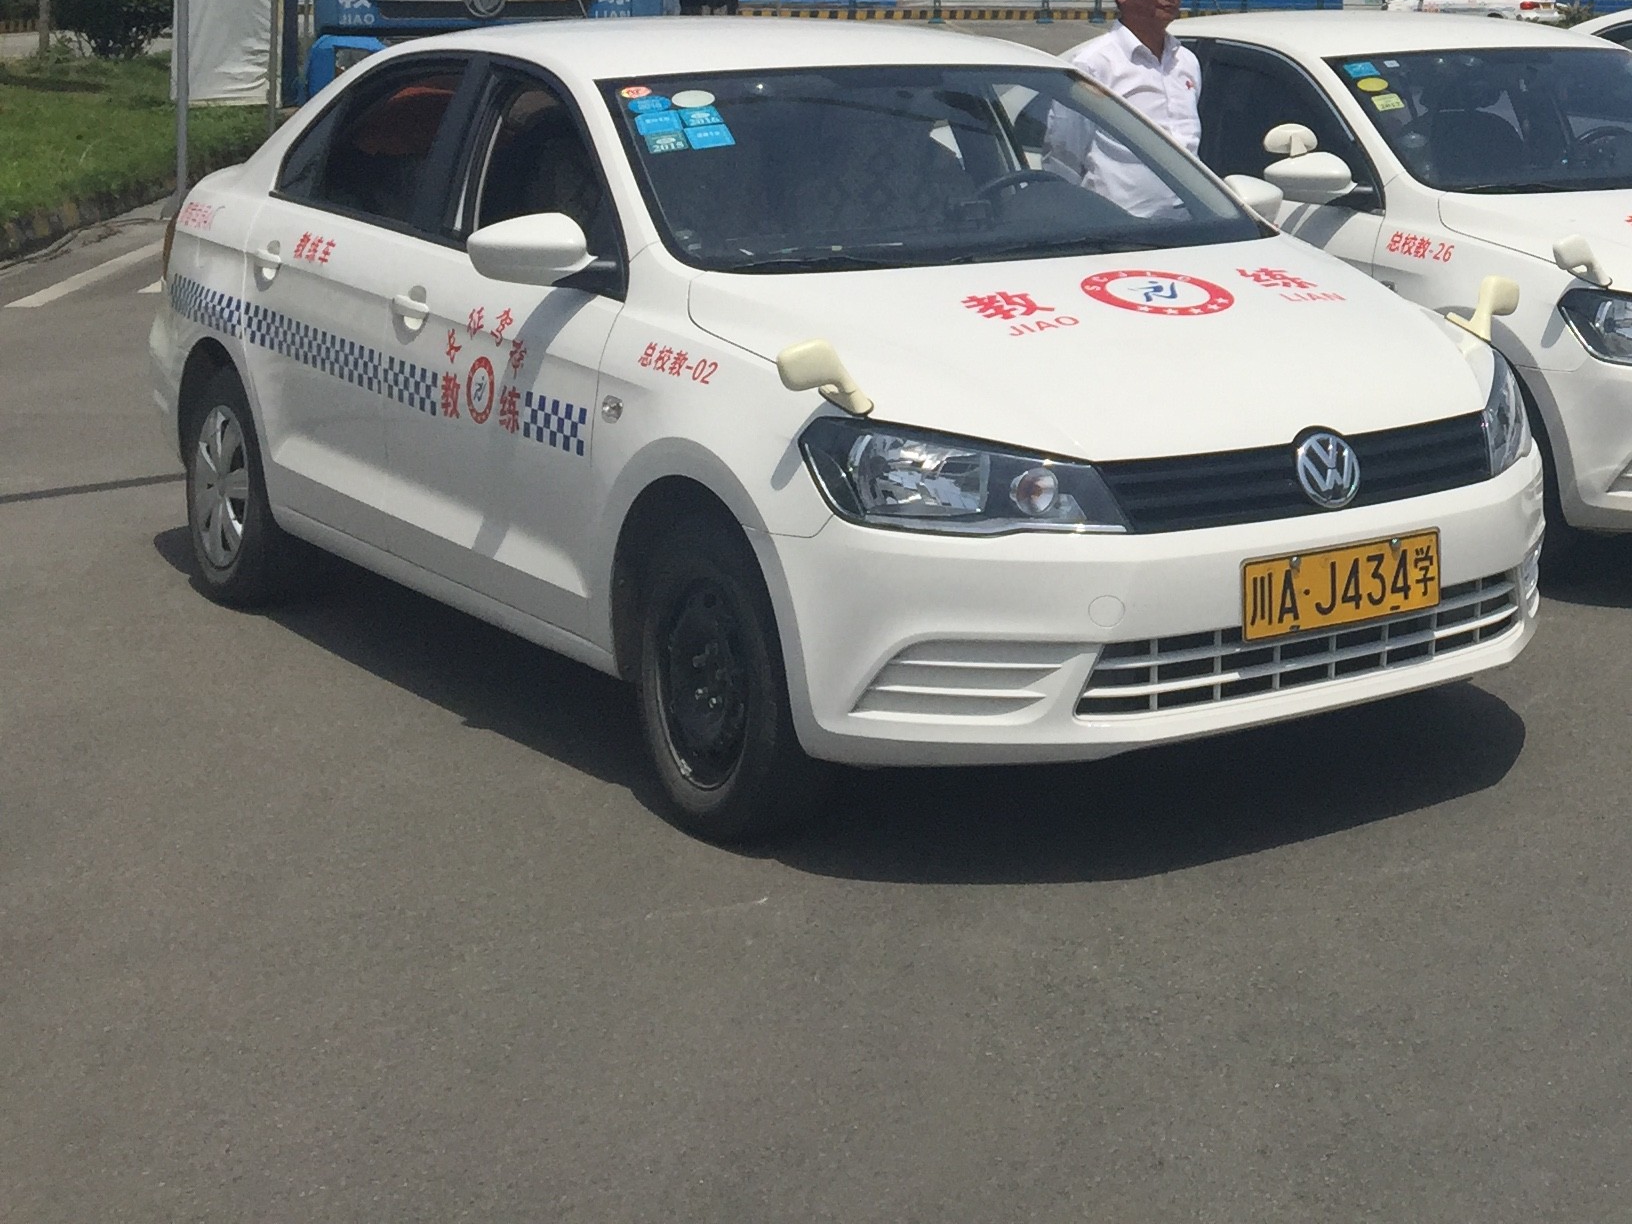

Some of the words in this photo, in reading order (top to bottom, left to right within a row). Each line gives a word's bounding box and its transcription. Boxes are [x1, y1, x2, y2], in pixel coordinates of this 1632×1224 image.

[293, 231, 337, 267] 教练车
[1386, 231, 1456, 263] 总校教-26
[959, 291, 1056, 320] 教
[1008, 316, 1080, 337] JIAO
[1279, 292, 1346, 303] LIAN
[638, 341, 719, 385] 总校教-02
[441, 371, 461, 419] 教
[1250, 544, 1436, 627] 川A·J434学
